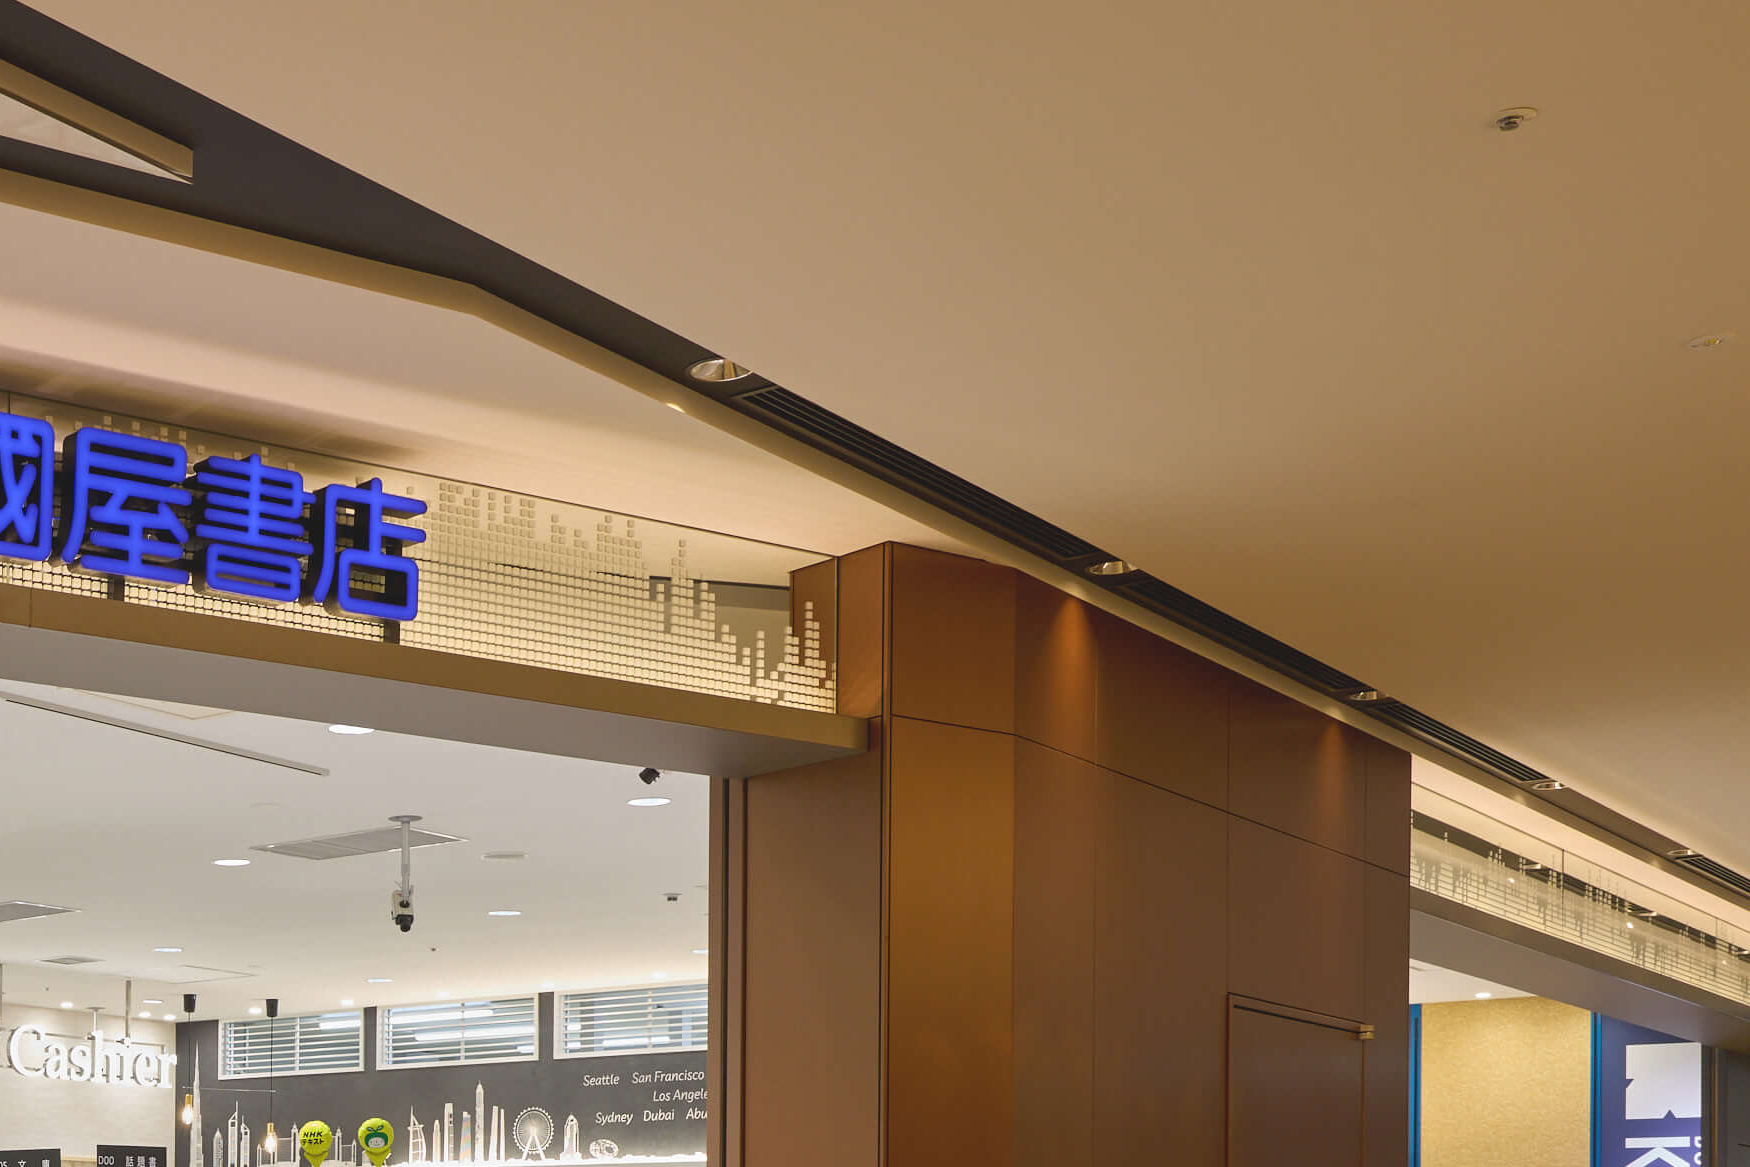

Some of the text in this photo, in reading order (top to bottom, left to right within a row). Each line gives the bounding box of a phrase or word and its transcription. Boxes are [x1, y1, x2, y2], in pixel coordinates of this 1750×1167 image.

[8, 1024, 178, 1088] Cashier
[583, 1069, 705, 1087] Seattle San Francisco
[653, 1090, 671, 1101] Los
[595, 1112, 634, 1126] Sydney
[643, 1109, 675, 1121] Dubai
[98, 1155, 158, 1167] D00 話題書
